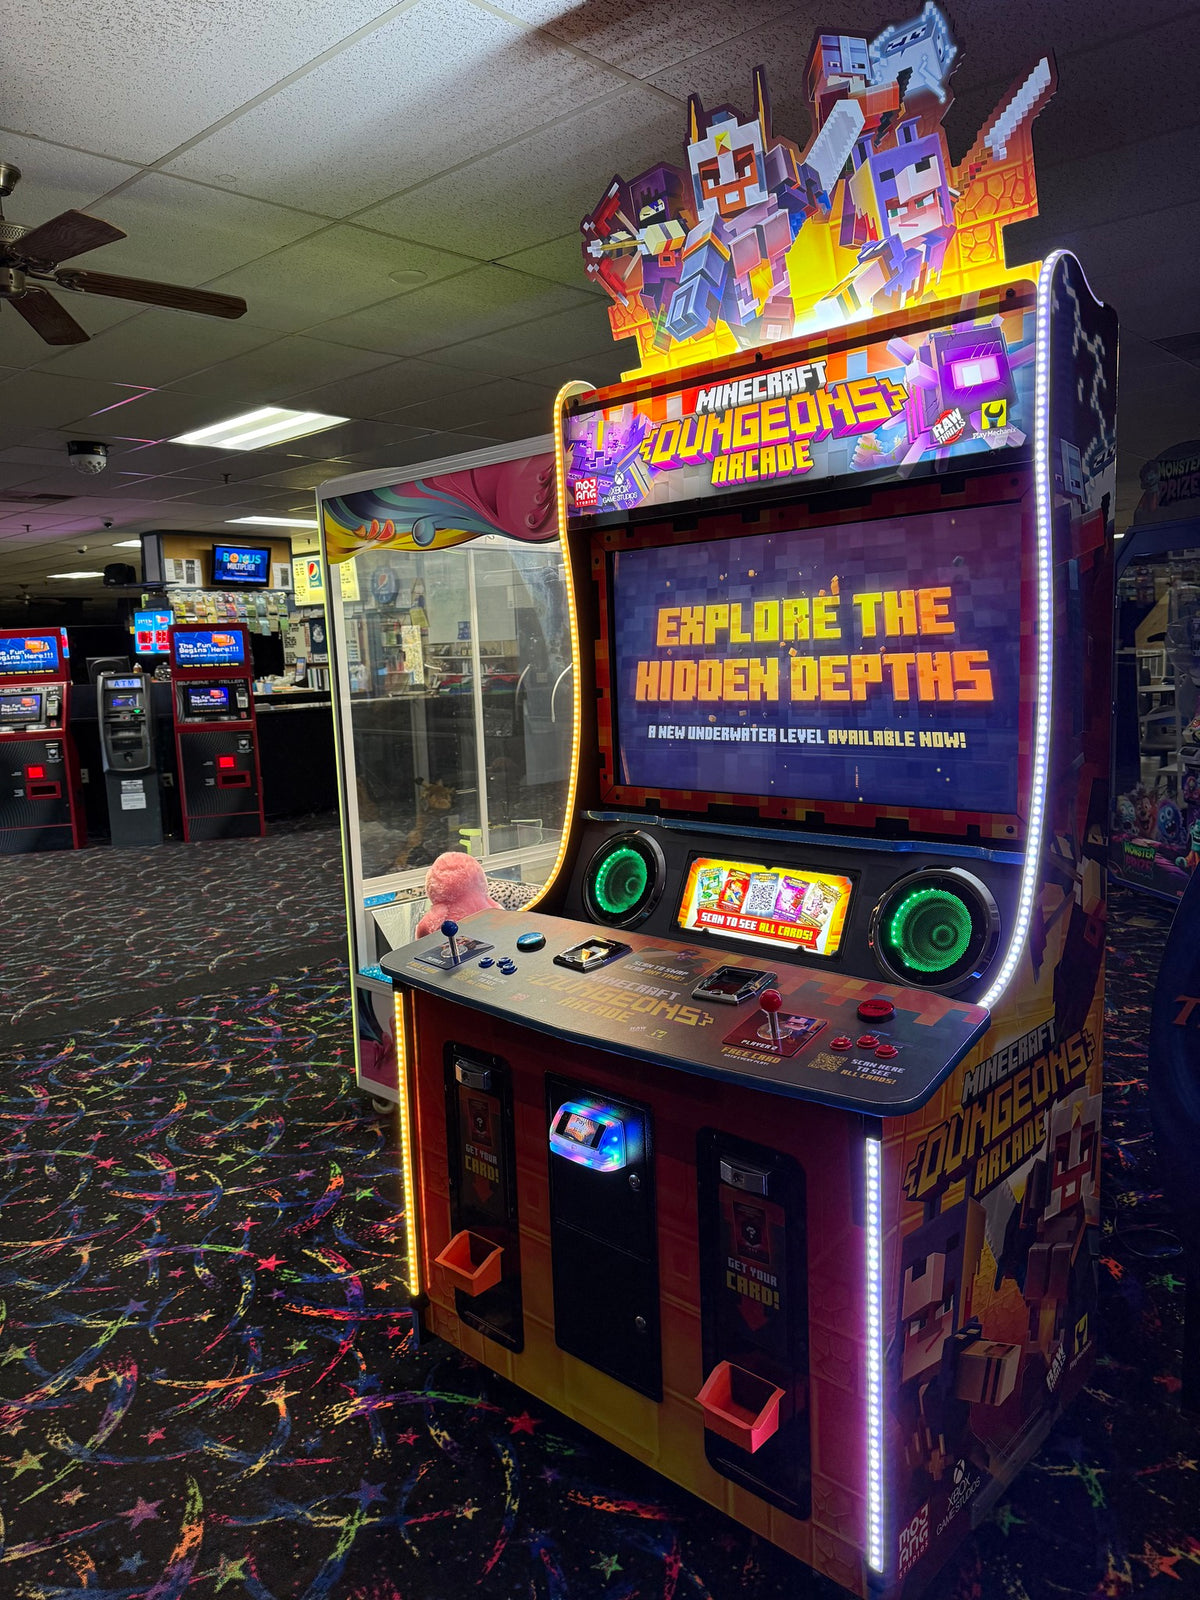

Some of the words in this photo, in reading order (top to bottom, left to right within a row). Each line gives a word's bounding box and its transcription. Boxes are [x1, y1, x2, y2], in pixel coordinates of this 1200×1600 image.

[696, 361, 827, 415] MINECRAFT
[648, 377, 897, 470] DUNGEONS
[932, 407, 962, 438] RAW
[937, 419, 966, 444] THRILLS
[711, 440, 813, 487] ARCADE
[576, 489, 597, 501] ANG
[602, 495, 617, 504] GAME
[617, 491, 638, 501] STUDIOS
[609, 484, 629, 496] XBOX
[223, 552, 262, 564] BONUS
[656, 595, 842, 647] EXPLORE
[853, 586, 955, 638] THE
[179, 647, 207, 655] Begins
[635, 656, 779, 701] HIDDEN
[790, 650, 994, 701] DEPTHS
[648, 725, 656, 739] A
[657, 725, 685, 740] NEW
[688, 726, 776, 743] UNDERWATER
[779, 728, 825, 744] LEVEL
[828, 729, 916, 747] AVAILABLE
[919, 731, 967, 749] NOW!
[701, 911, 724, 925] SCAN
[725, 914, 738, 927] TO
[738, 917, 758, 931] SEE
[758, 923, 776, 936] ALL
[777, 926, 814, 941] CARDS!
[529, 974, 704, 1026] DUNGEONS
[584, 973, 681, 1001] MINECRAFT
[556, 996, 639, 1023] ARCADE
[721, 1046, 752, 1057] FREE
[751, 1052, 782, 1064] CARD
[740, 1039, 772, 1049] PLAYER
[851, 1058, 878, 1068] SCAN
[878, 1064, 906, 1074] HERE
[856, 1065, 870, 1073] TO
[870, 1068, 892, 1077] SEE
[962, 1018, 1056, 1104] MINECRAFT
[840, 1069, 858, 1078] ALL
[859, 1073, 897, 1085] CARDS!
[914, 1031, 1090, 1199] DUNGEONS
[464, 1154, 500, 1184] CARD!
[465, 1143, 479, 1156] GET
[479, 1150, 498, 1165] YOUR
[973, 1111, 1047, 1197] ARCADE
[727, 1256, 748, 1273] GET
[750, 1266, 778, 1287] YOUR
[726, 1269, 780, 1310] CARD!
[936, 1508, 957, 1536] GAME
[955, 1476, 981, 1513] STUDIOS
[947, 1471, 971, 1512] XBOX
[899, 1503, 929, 1551] MOJ
[899, 1521, 929, 1570] ANG
[899, 1540, 929, 1580] STUDIOS
